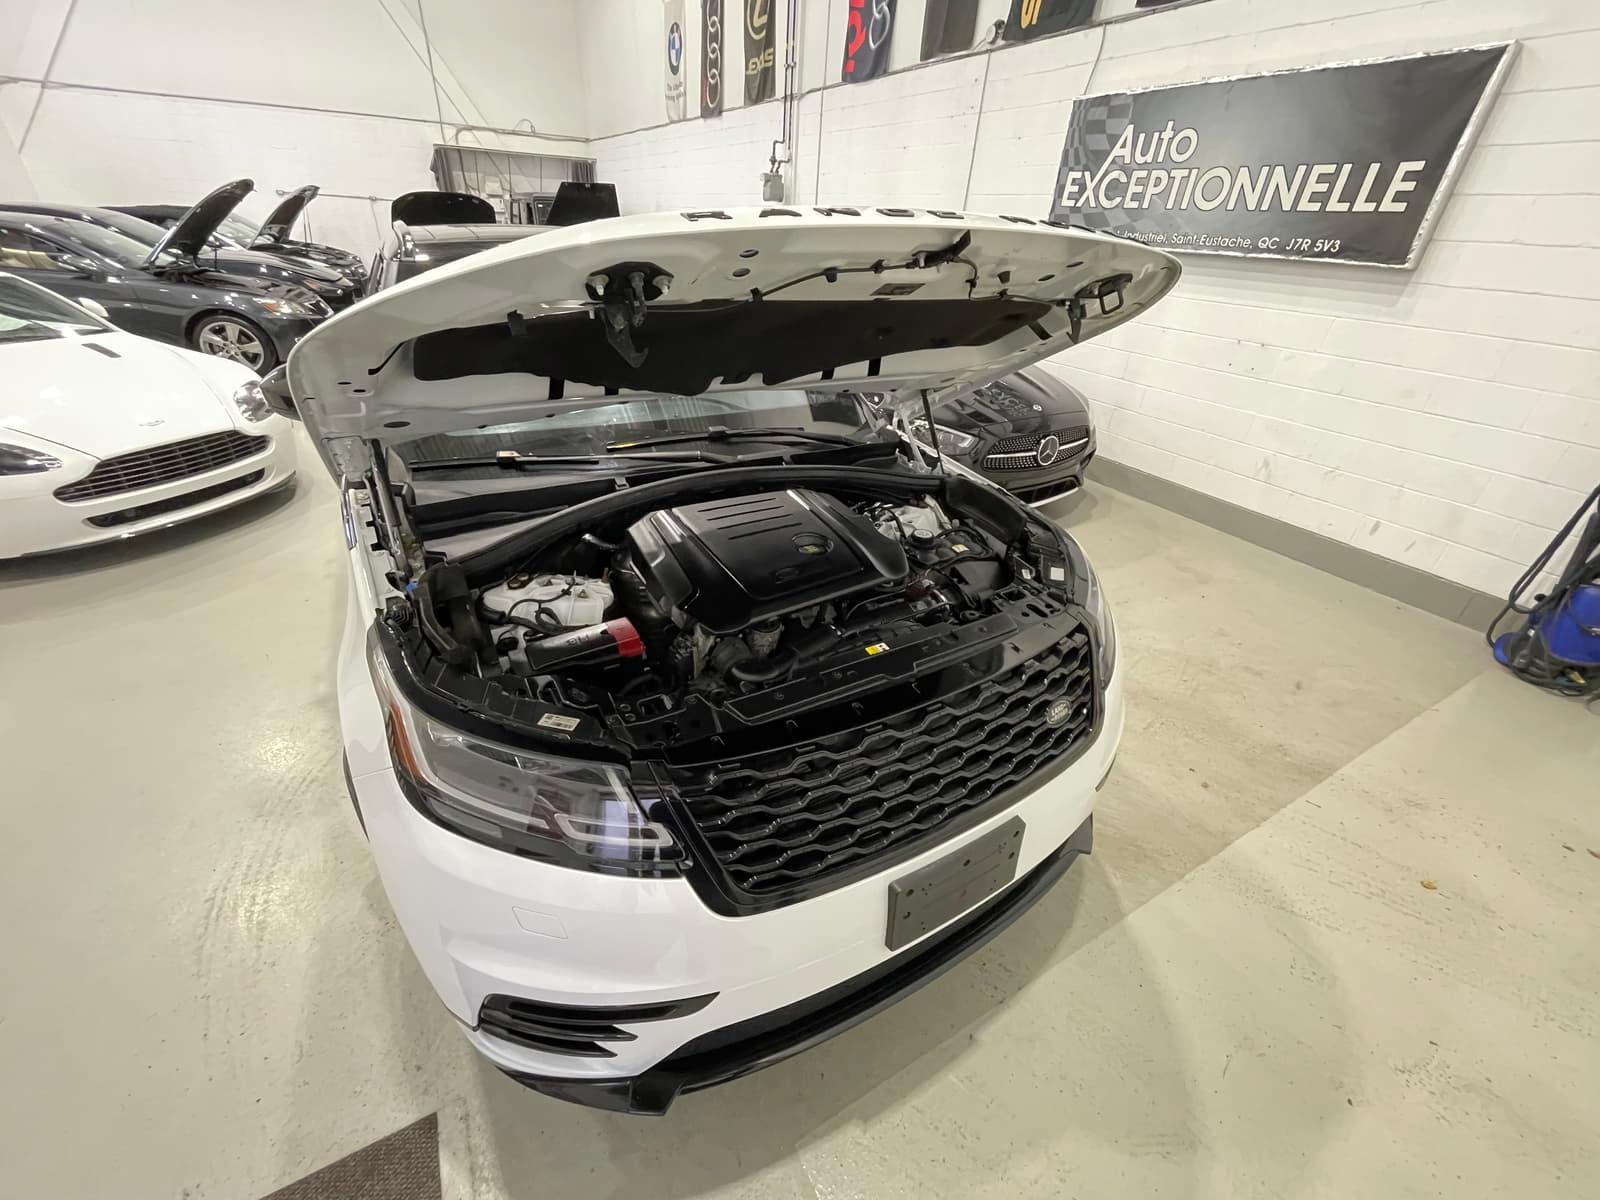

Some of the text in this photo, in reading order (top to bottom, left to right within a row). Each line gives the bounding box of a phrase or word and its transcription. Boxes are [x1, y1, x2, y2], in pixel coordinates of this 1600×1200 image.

[1109, 120, 1200, 165] Auto
[1060, 160, 1427, 212] EXCEPTIONNELLE
[1171, 233, 1253, 249] Saint-Eustache,
[1257, 236, 1281, 250] QC
[1285, 237, 1312, 251] J7R
[1313, 238, 1341, 252] 5V3
